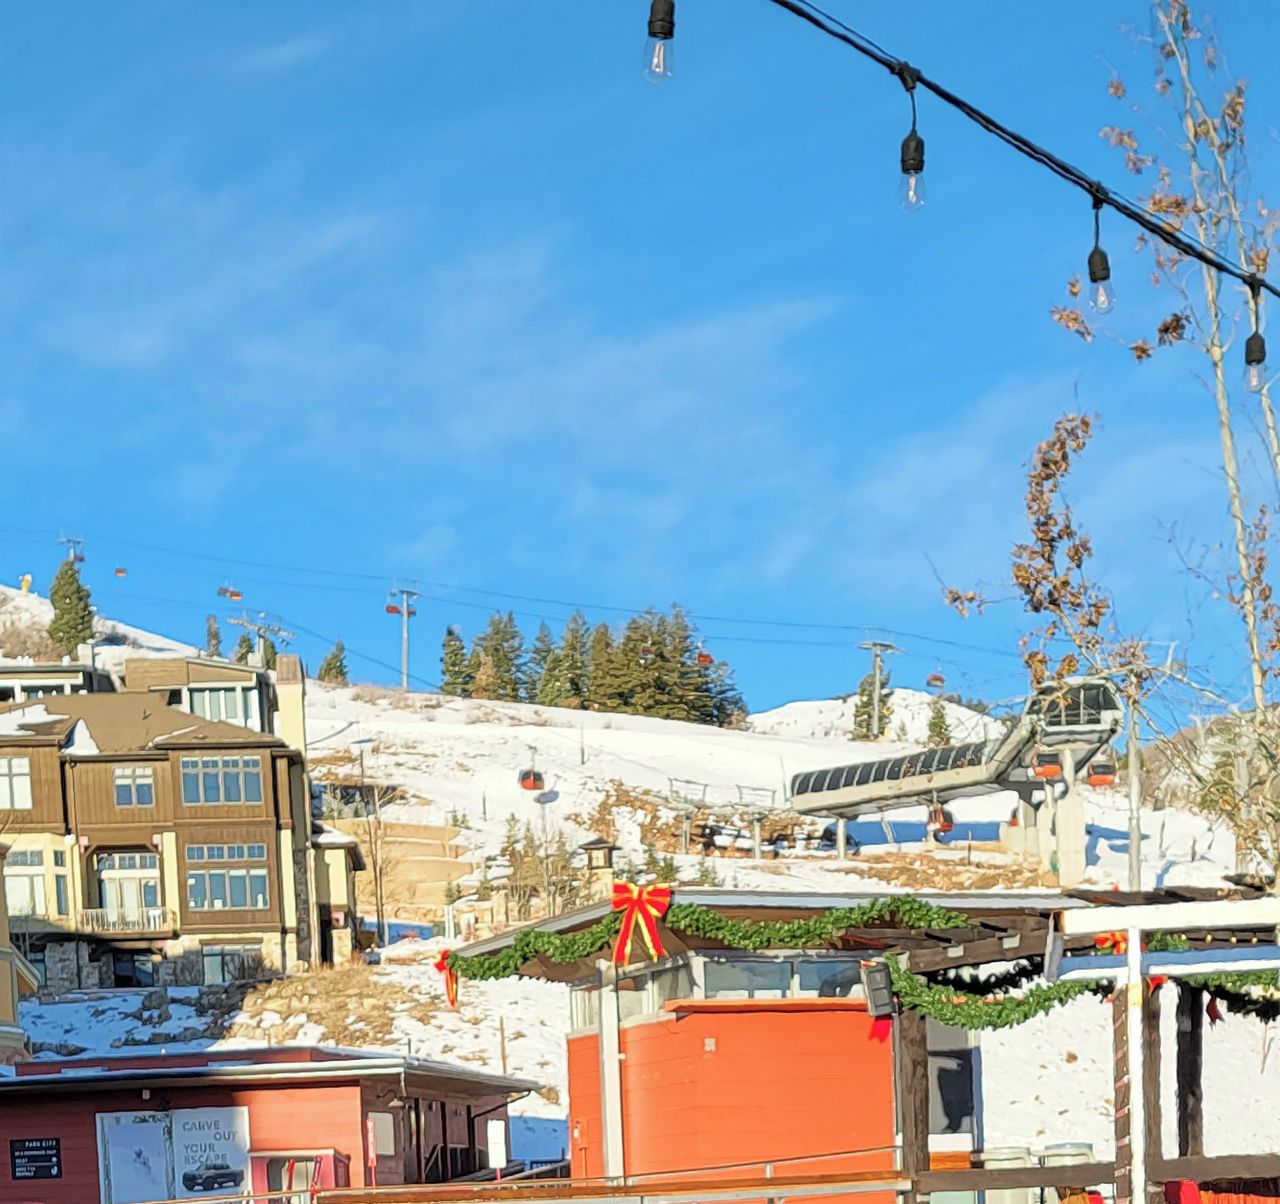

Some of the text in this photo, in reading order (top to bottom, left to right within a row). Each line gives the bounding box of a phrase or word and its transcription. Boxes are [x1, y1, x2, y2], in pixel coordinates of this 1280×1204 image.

[182, 1120, 220, 1131] CARVE
[213, 1130, 238, 1142] OUT
[183, 1143, 216, 1153] YOUR
